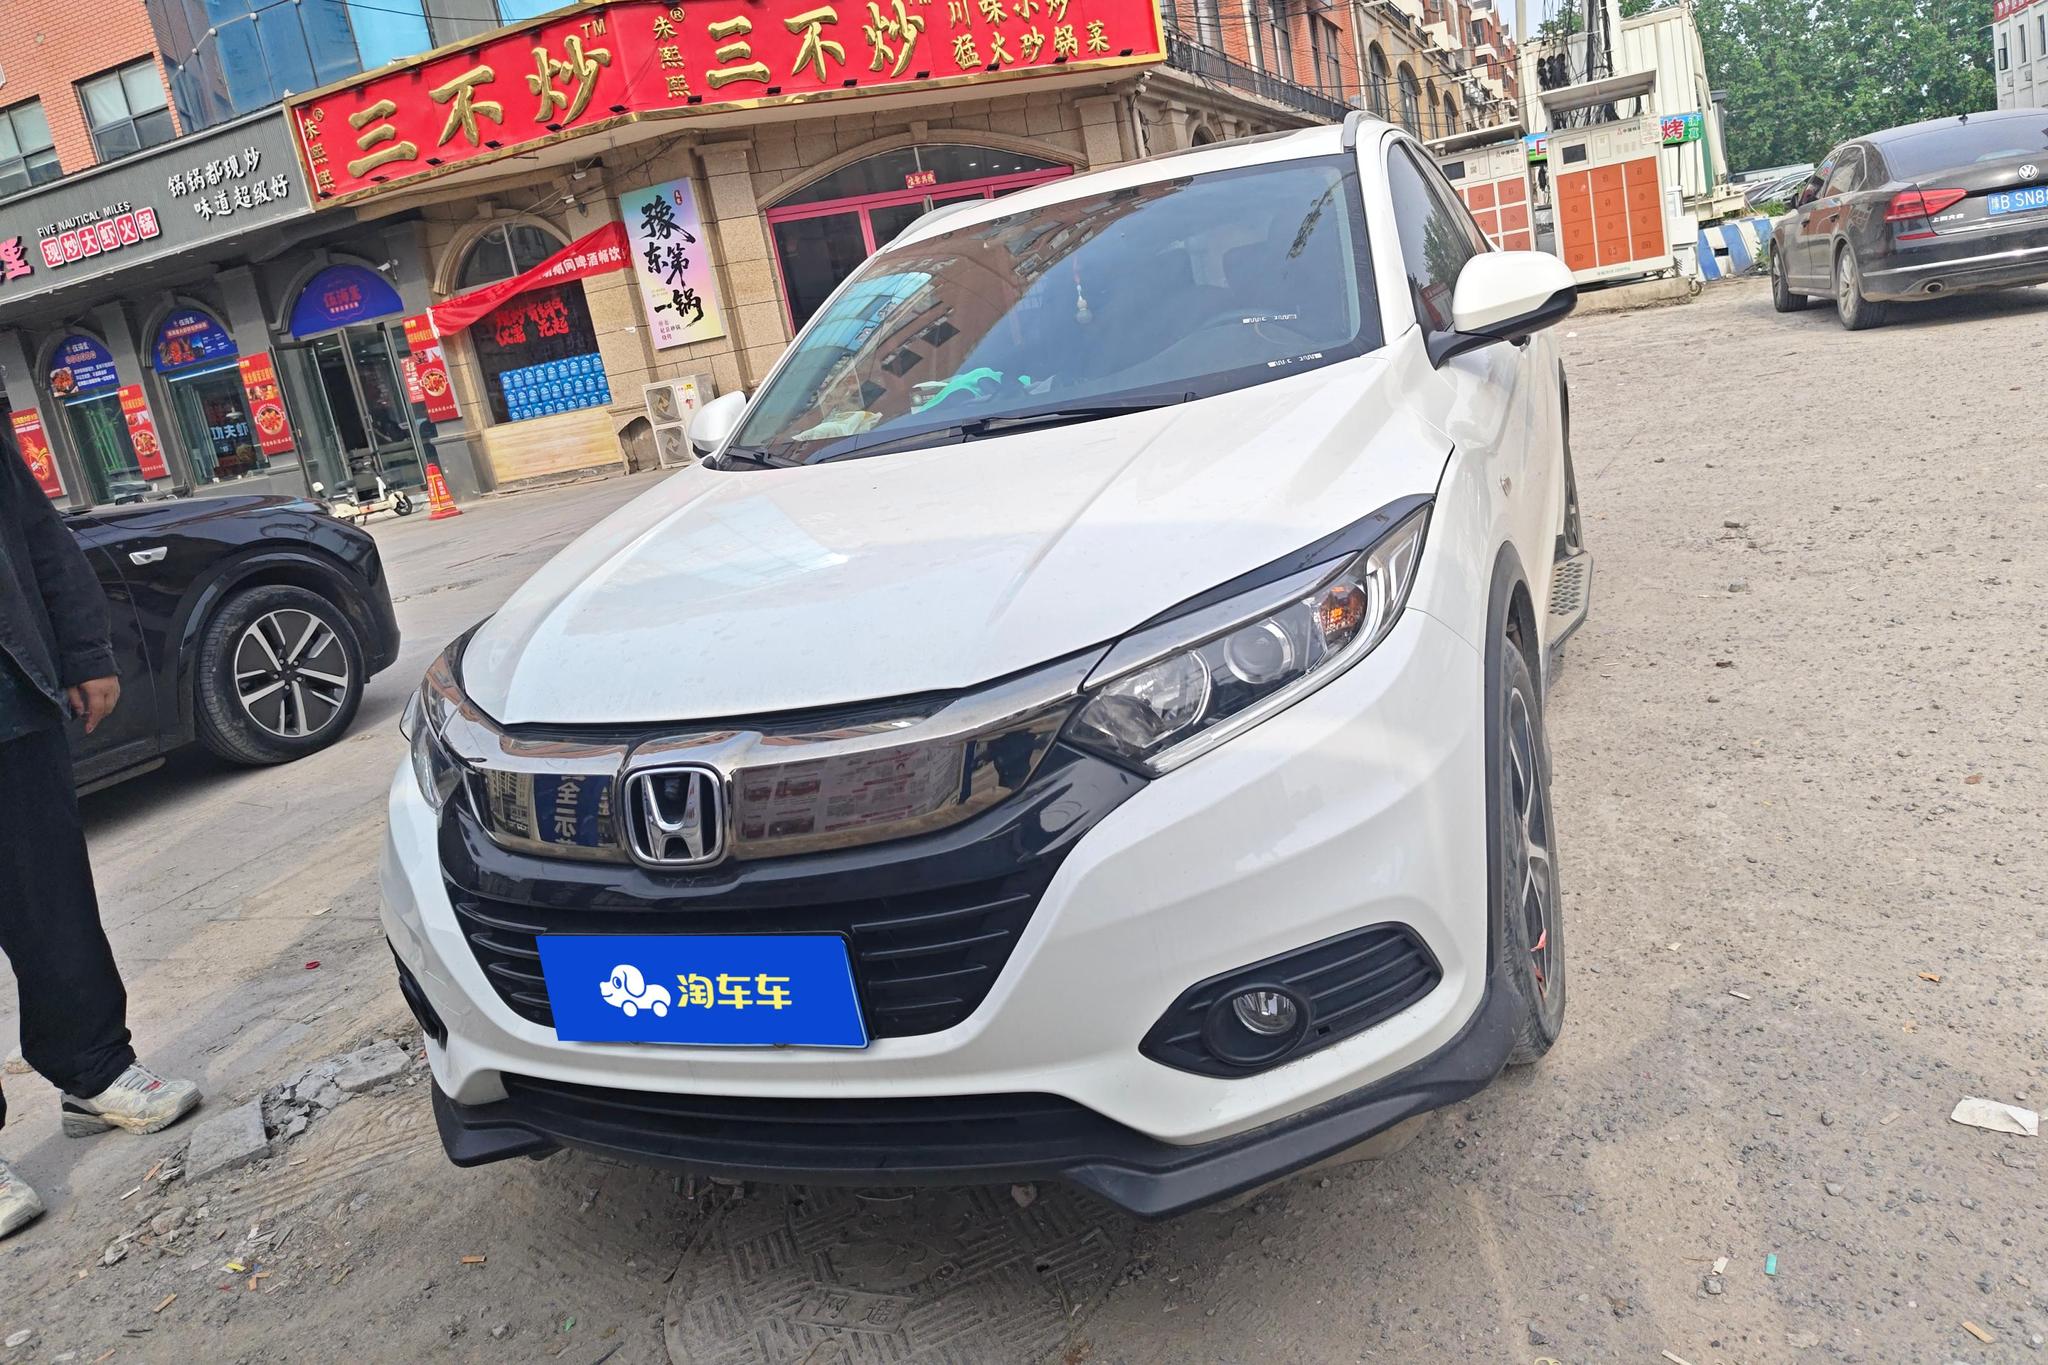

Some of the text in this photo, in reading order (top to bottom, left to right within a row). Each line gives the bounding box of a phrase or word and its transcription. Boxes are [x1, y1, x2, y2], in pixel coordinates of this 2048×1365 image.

[580, 19, 606, 38] TM
[705, 0, 925, 89] 三不炒
[347, 35, 612, 177] 三不炒
[168, 147, 260, 198] 锅锅都现炒
[194, 173, 288, 220] 味道超级好
[37, 201, 130, 237] FIVE NAUTICAL MILES
[2015, 189, 2048, 207] SN8
[42, 210, 157, 263] 现炒大虾火锅
